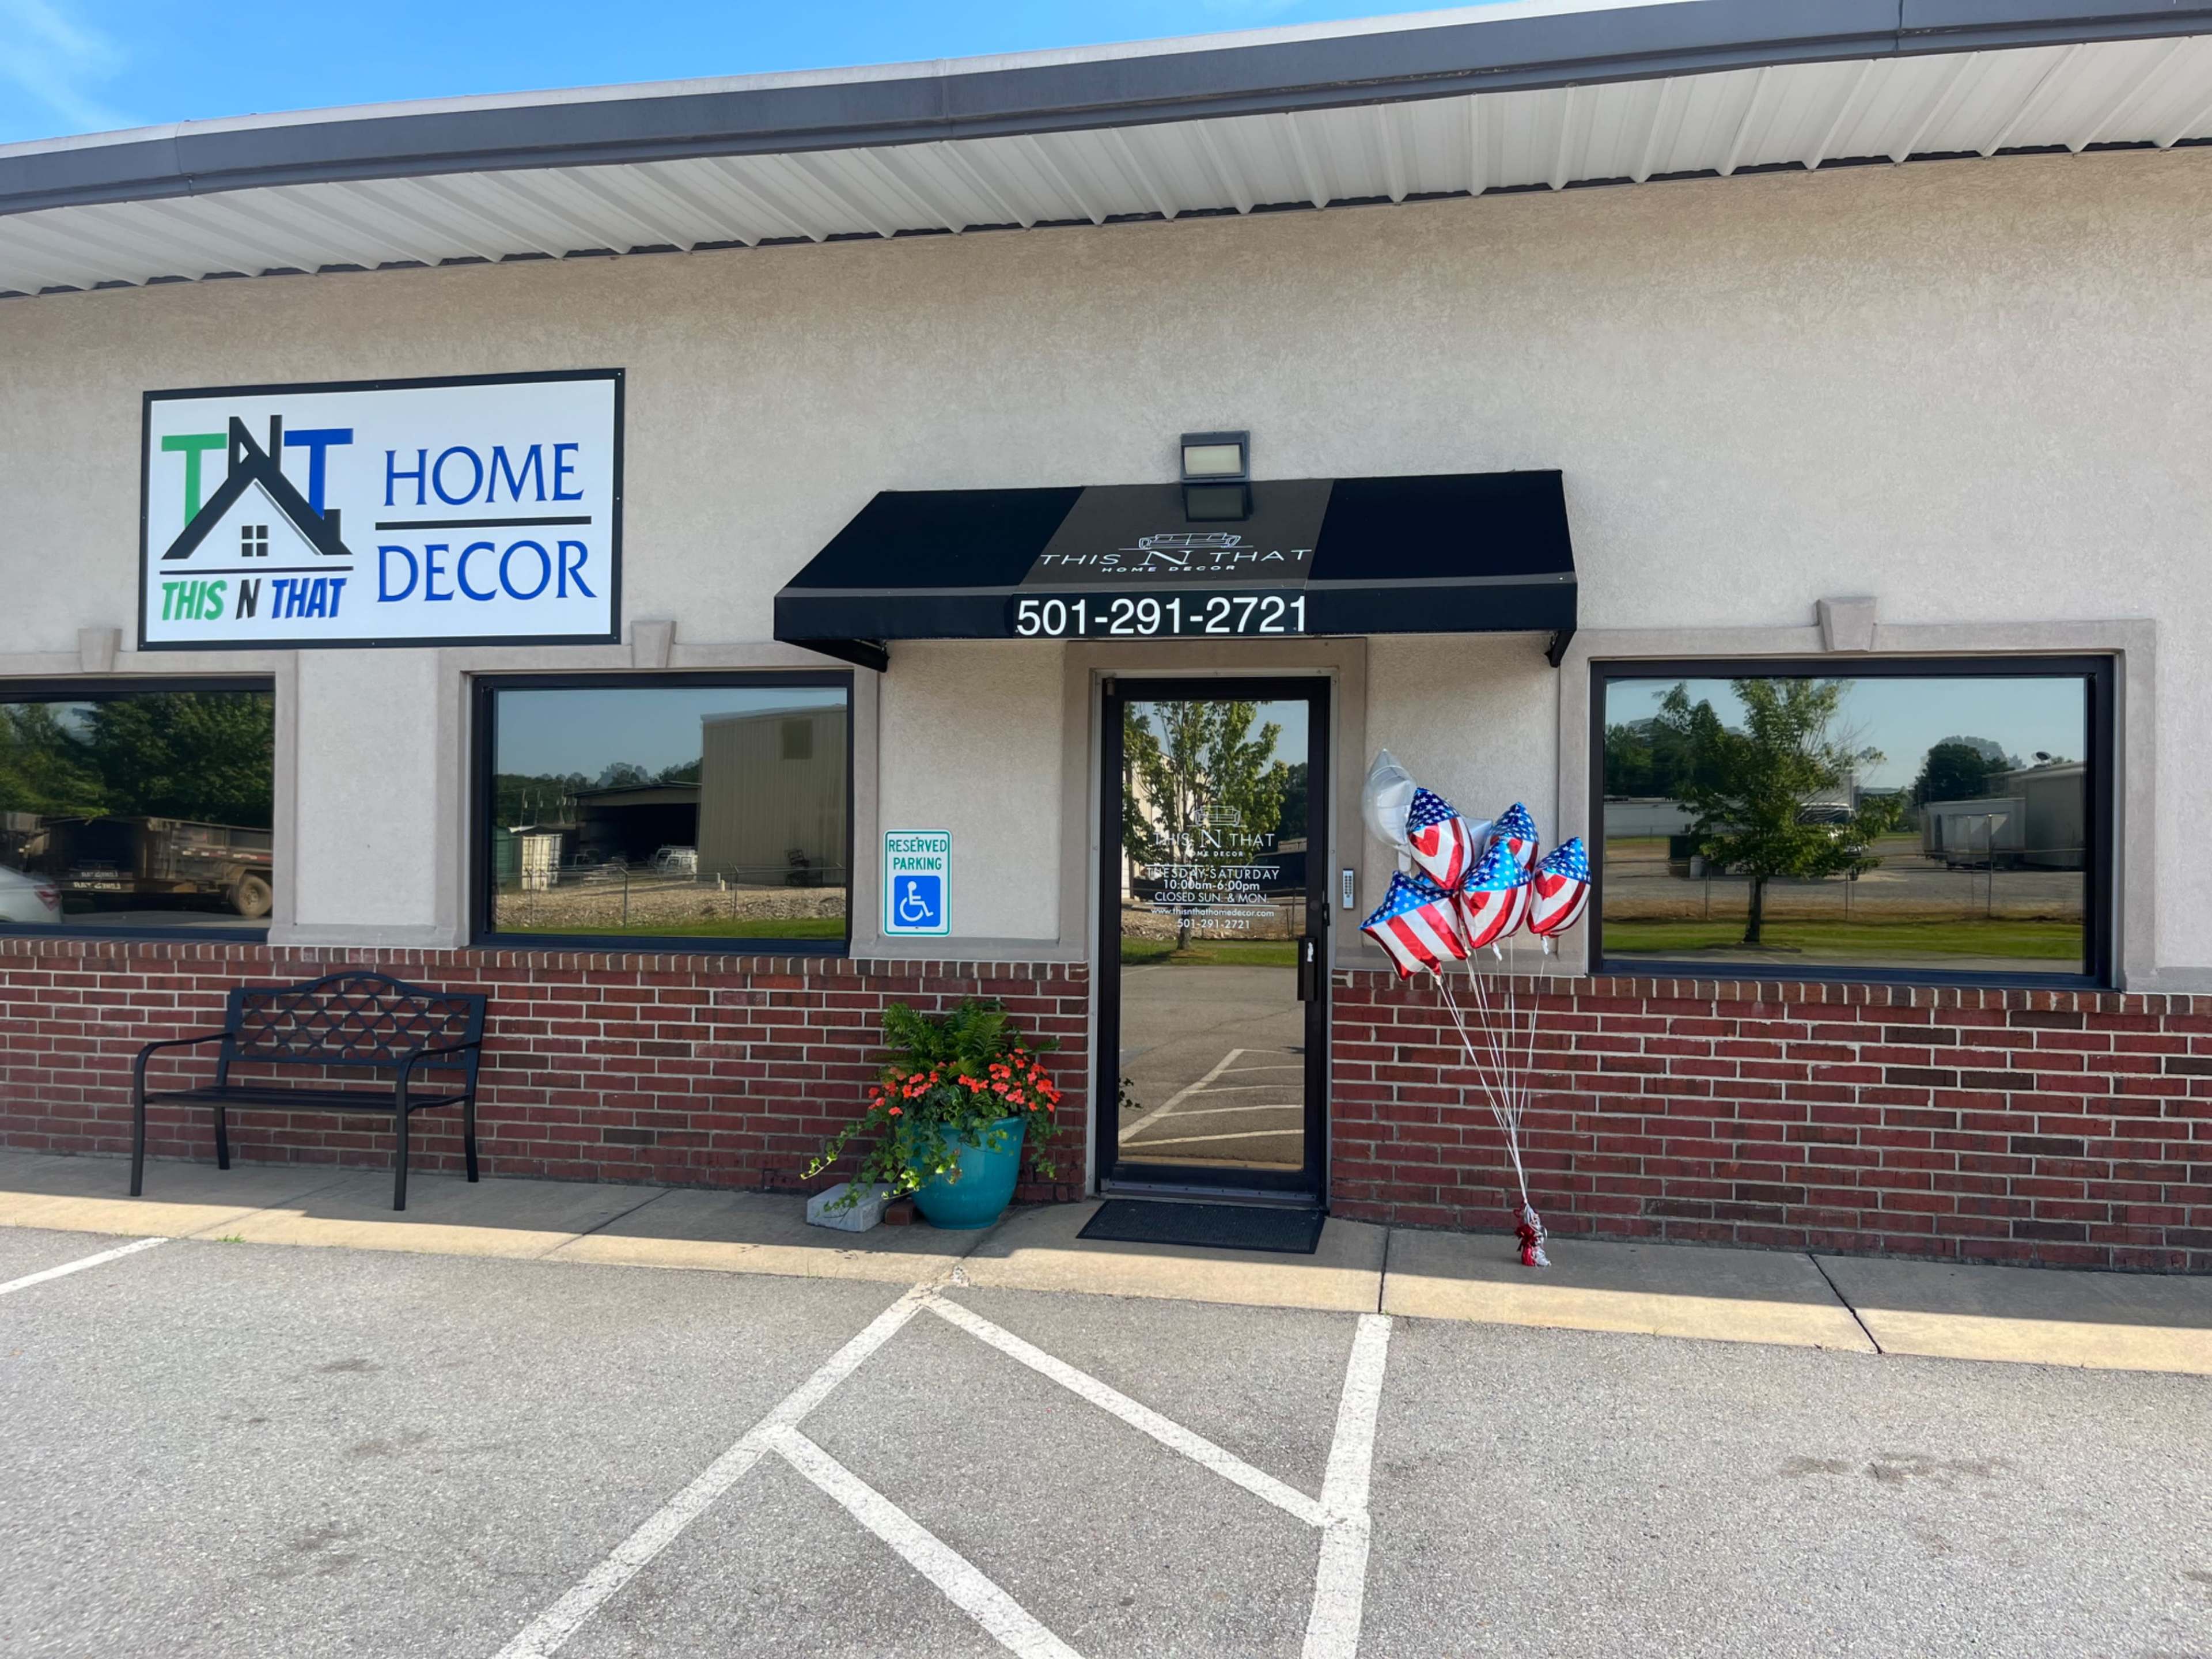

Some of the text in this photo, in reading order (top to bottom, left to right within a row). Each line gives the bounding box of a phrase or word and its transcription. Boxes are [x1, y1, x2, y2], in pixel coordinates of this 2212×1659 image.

[162, 414, 354, 529] TNT
[384, 442, 584, 506] HOME
[377, 540, 597, 603] DECOR
[1040, 549, 1313, 566] THIS N THAT
[161, 577, 347, 620] THIS N THAT
[1016, 596, 1306, 635] 501-291-2721
[888, 839, 948, 853] RESERVED
[1153, 829, 1275, 849] THIS N THAT
[893, 857, 942, 870] PARKING
[1154, 892, 1195, 902] CLOSED
[1227, 893, 1235, 903] &
